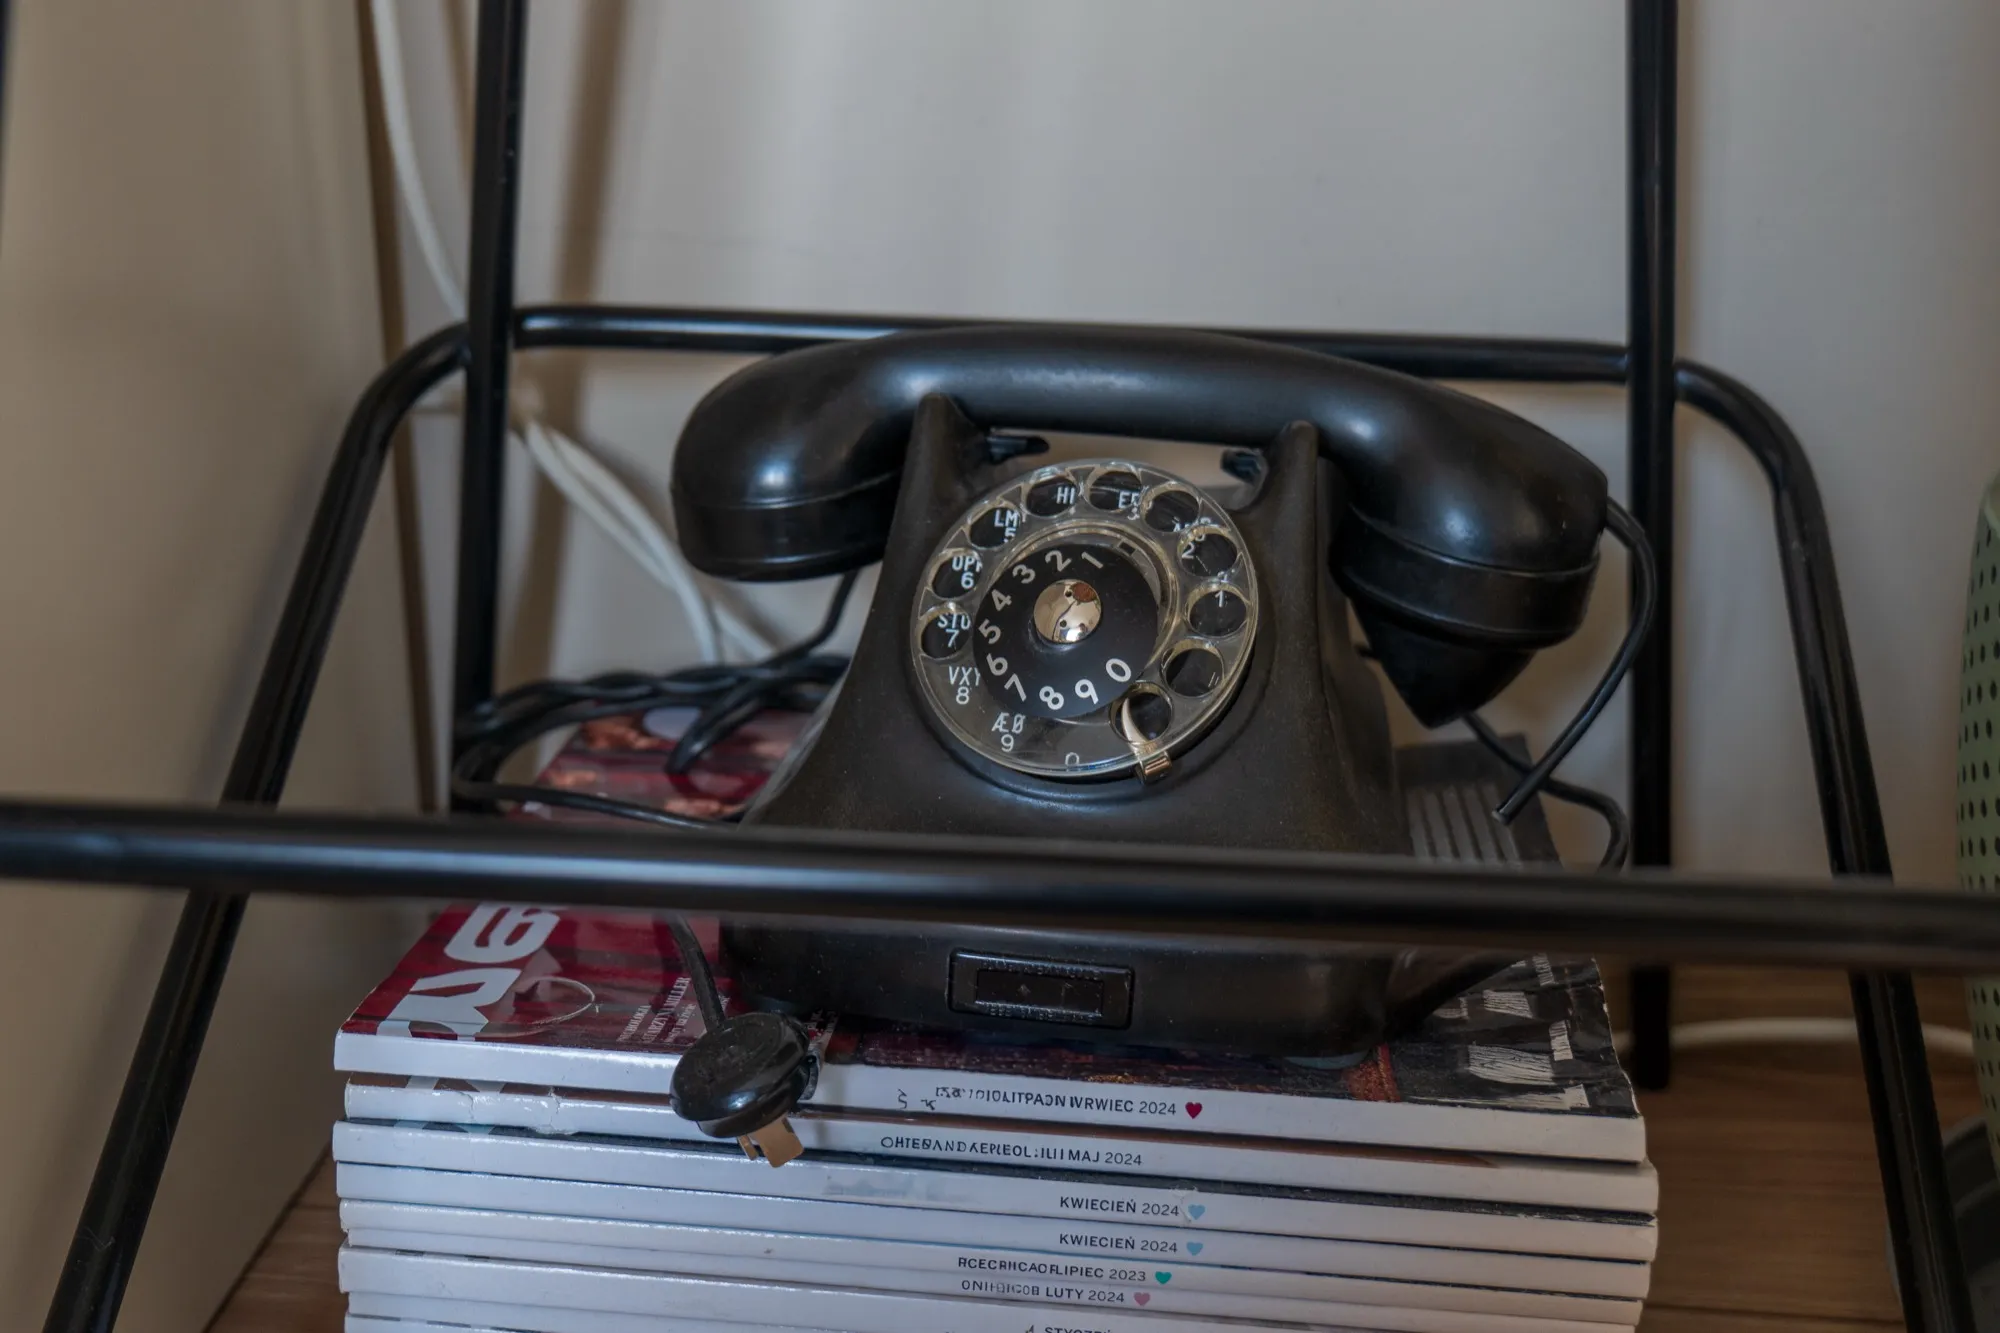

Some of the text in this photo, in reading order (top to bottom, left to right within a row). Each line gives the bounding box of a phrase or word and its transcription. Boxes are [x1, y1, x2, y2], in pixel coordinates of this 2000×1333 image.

[1003, 527, 1017, 543] 5
[1081, 551, 1104, 569] 1
[1181, 542, 1196, 560] 2
[1044, 550, 1073, 573] 2
[960, 571, 974, 589] 6
[1012, 564, 1036, 584] 3
[991, 588, 1013, 611] 4
[1214, 590, 1225, 608] 1
[937, 613, 971, 631] STU
[978, 618, 1002, 644] 5
[945, 629, 959, 648] 7
[986, 653, 1009, 676] 6
[1106, 658, 1132, 682] 0
[955, 686, 970, 705] 8
[1004, 673, 1027, 702] 7
[1075, 678, 1099, 705] 9
[1039, 686, 1065, 710] 8
[1001, 734, 1014, 752] 9
[1139, 1101, 1176, 1115] 2024
[1069, 1149, 1099, 1162] MAJ
[1105, 1152, 1142, 1165] 2024
[1060, 1196, 1179, 1216] KWIECIEŃ 2024
[1058, 1233, 1177, 1252] KWIECIEŃ 2024
[1109, 1269, 1145, 1281] 2023
[1046, 1287, 1083, 1299] LUTY
[1087, 1290, 1125, 1304] 2024
